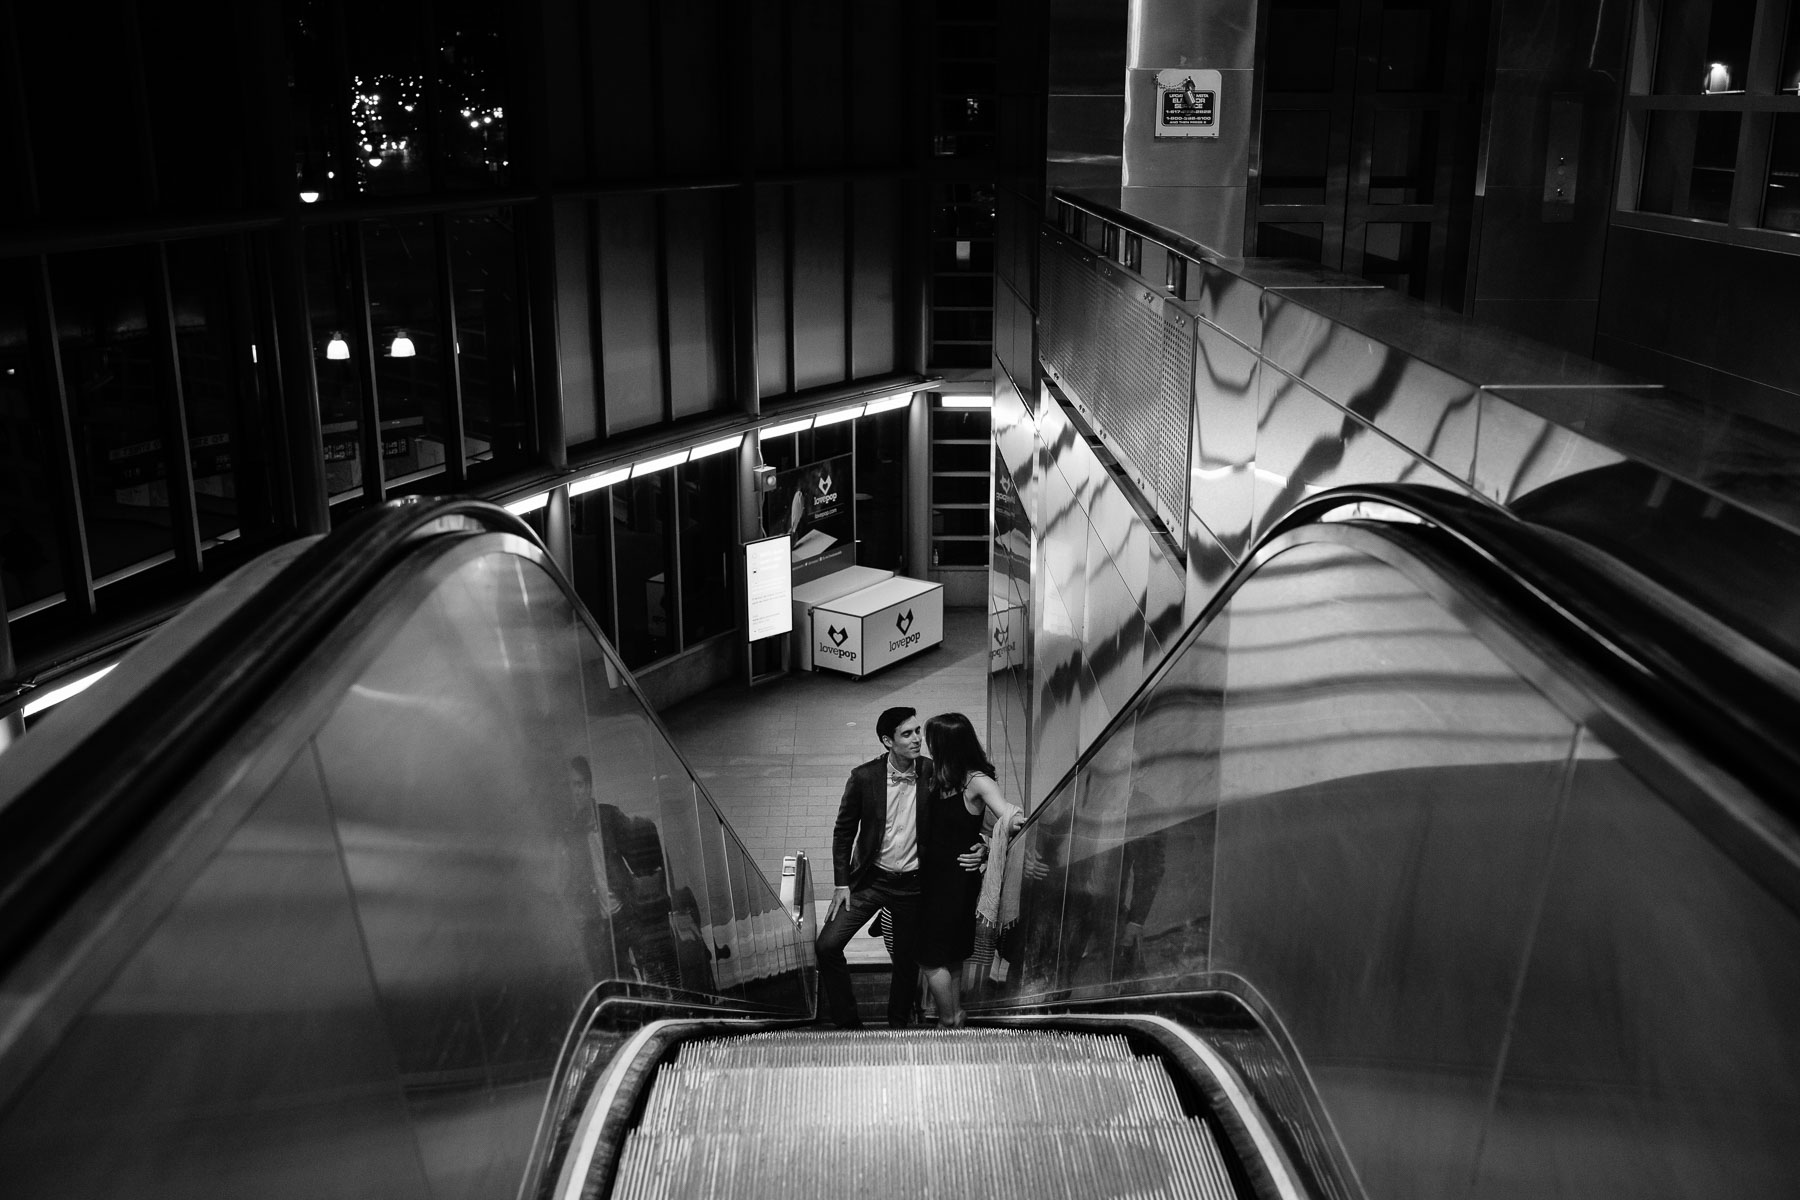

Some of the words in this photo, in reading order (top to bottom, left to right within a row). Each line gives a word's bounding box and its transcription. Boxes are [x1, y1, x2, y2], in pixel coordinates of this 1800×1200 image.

[813, 492, 837, 505] lovepop
[819, 642, 857, 661] lovepop
[889, 632, 921, 652] lovepop
